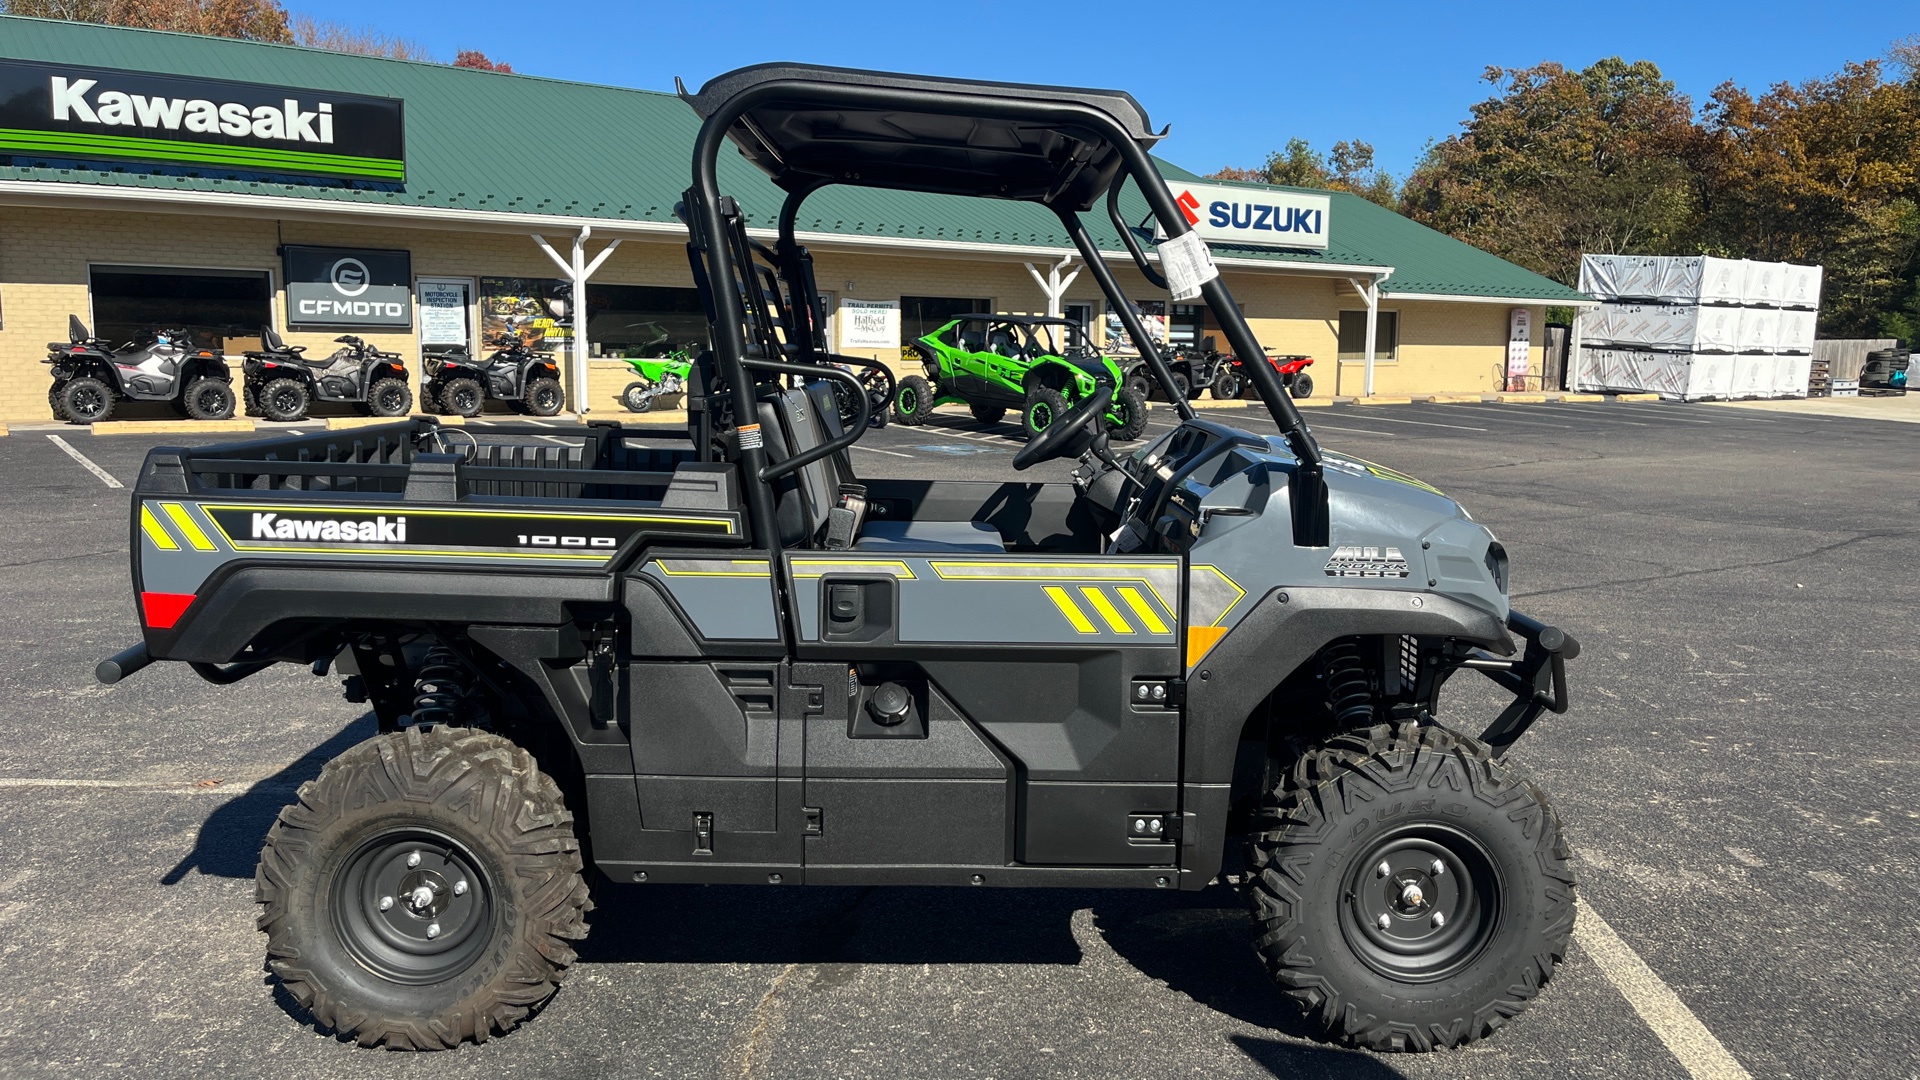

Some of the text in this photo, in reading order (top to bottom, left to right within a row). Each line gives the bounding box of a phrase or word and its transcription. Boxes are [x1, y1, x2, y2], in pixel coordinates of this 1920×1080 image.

[51, 76, 334, 144] Kawasaki
[1208, 201, 1321, 234] SUZUKI
[299, 299, 403, 317] CFMOTO
[854, 315, 885, 326] Hatfield
[252, 512, 406, 542] Kawasaki
[517, 535, 616, 546] 1000
[1328, 546, 1406, 562] MULE
[1350, 799, 1469, 843] DURO
